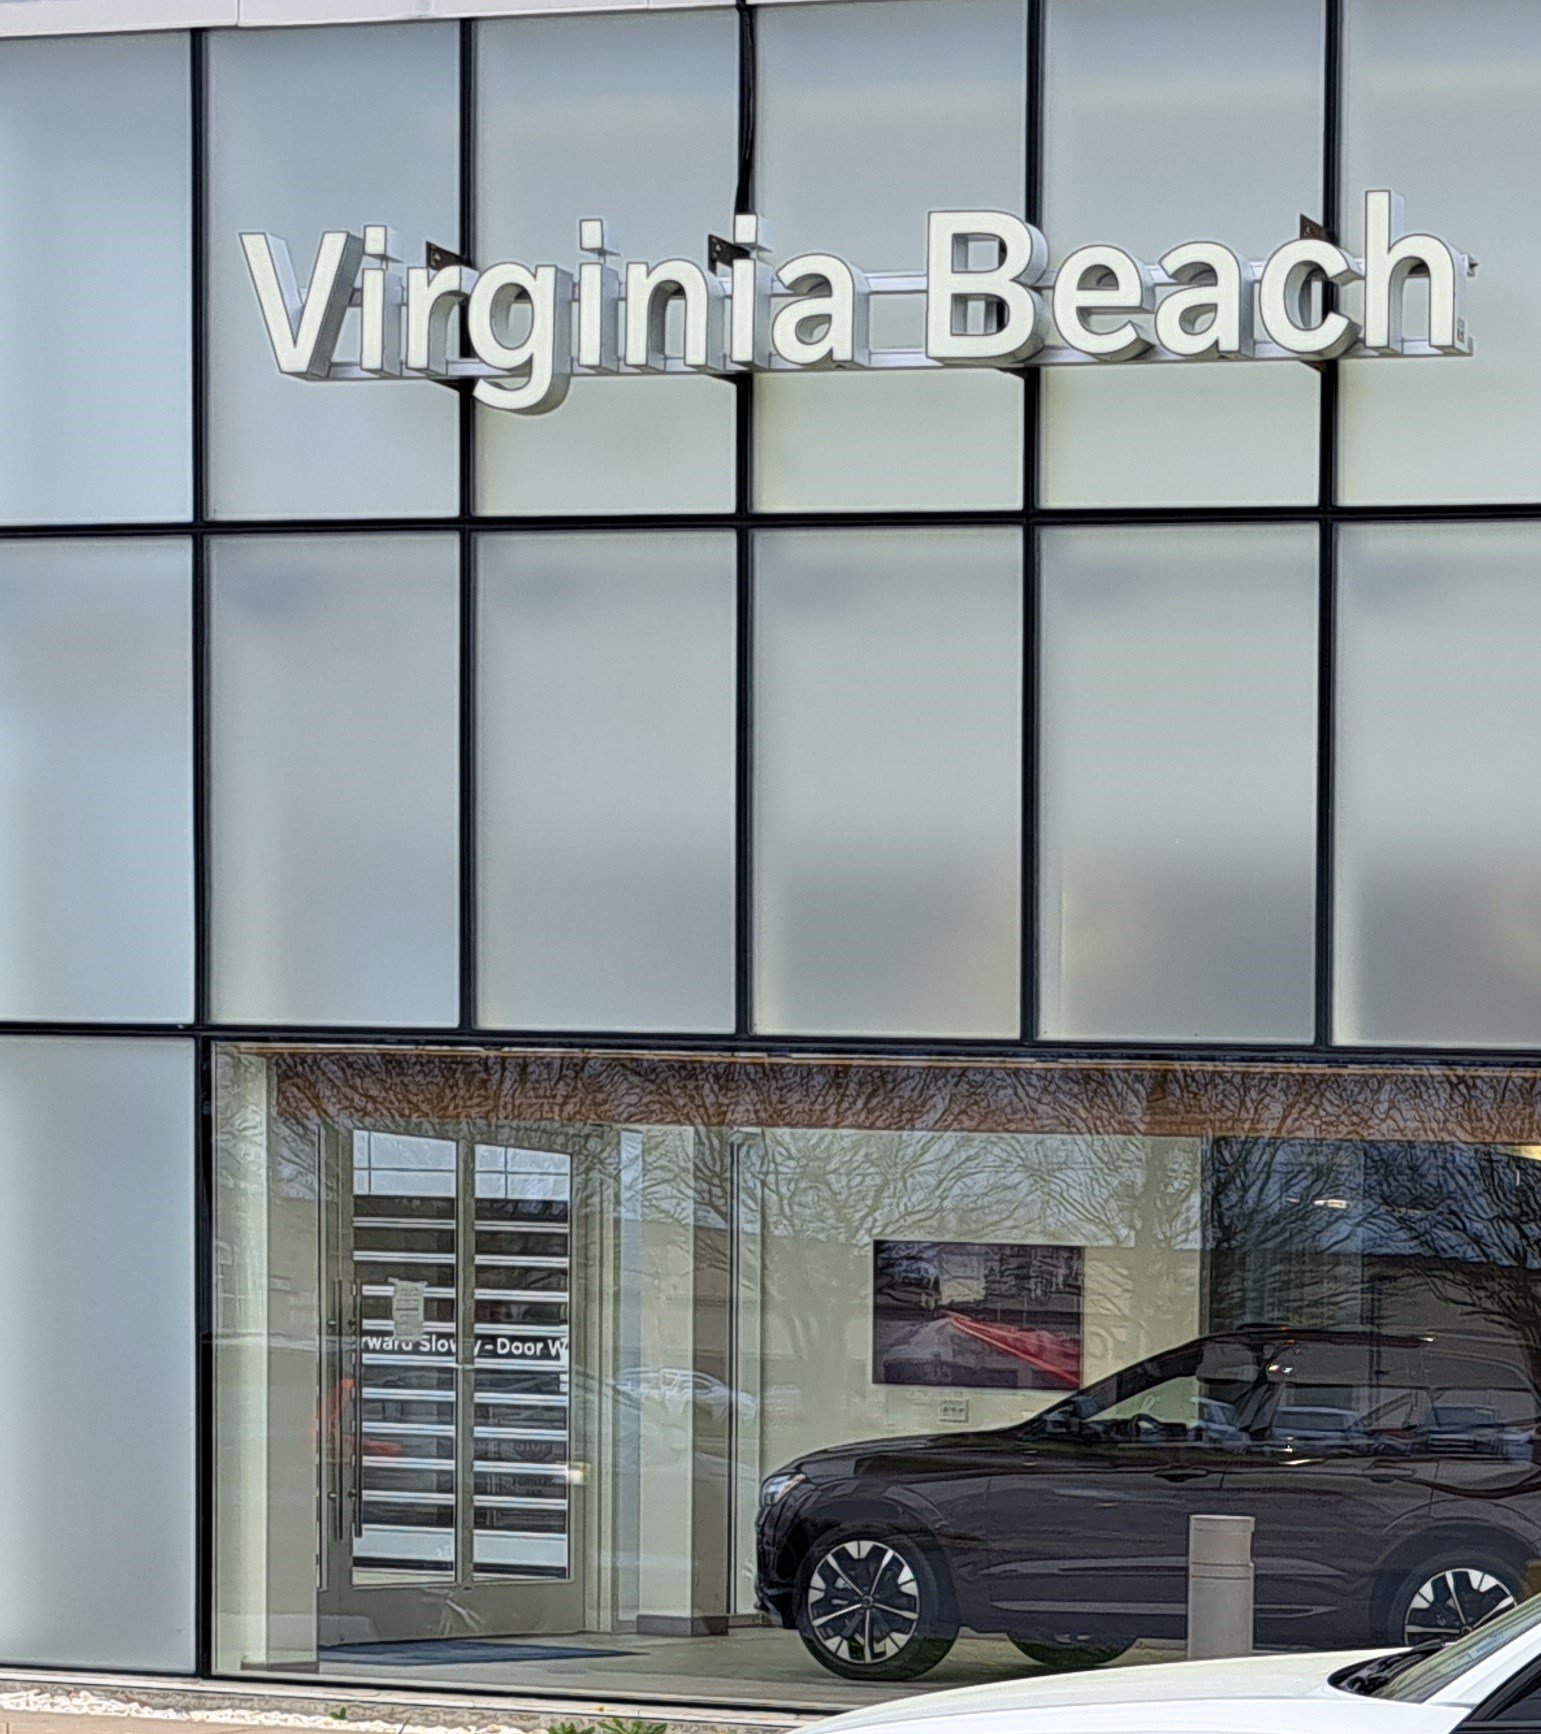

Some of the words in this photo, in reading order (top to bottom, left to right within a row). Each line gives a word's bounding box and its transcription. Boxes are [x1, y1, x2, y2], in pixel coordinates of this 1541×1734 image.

[239, 213, 864, 414] Virginia
[926, 190, 1464, 366] Beach
[496, 1337, 544, 1356] Door
